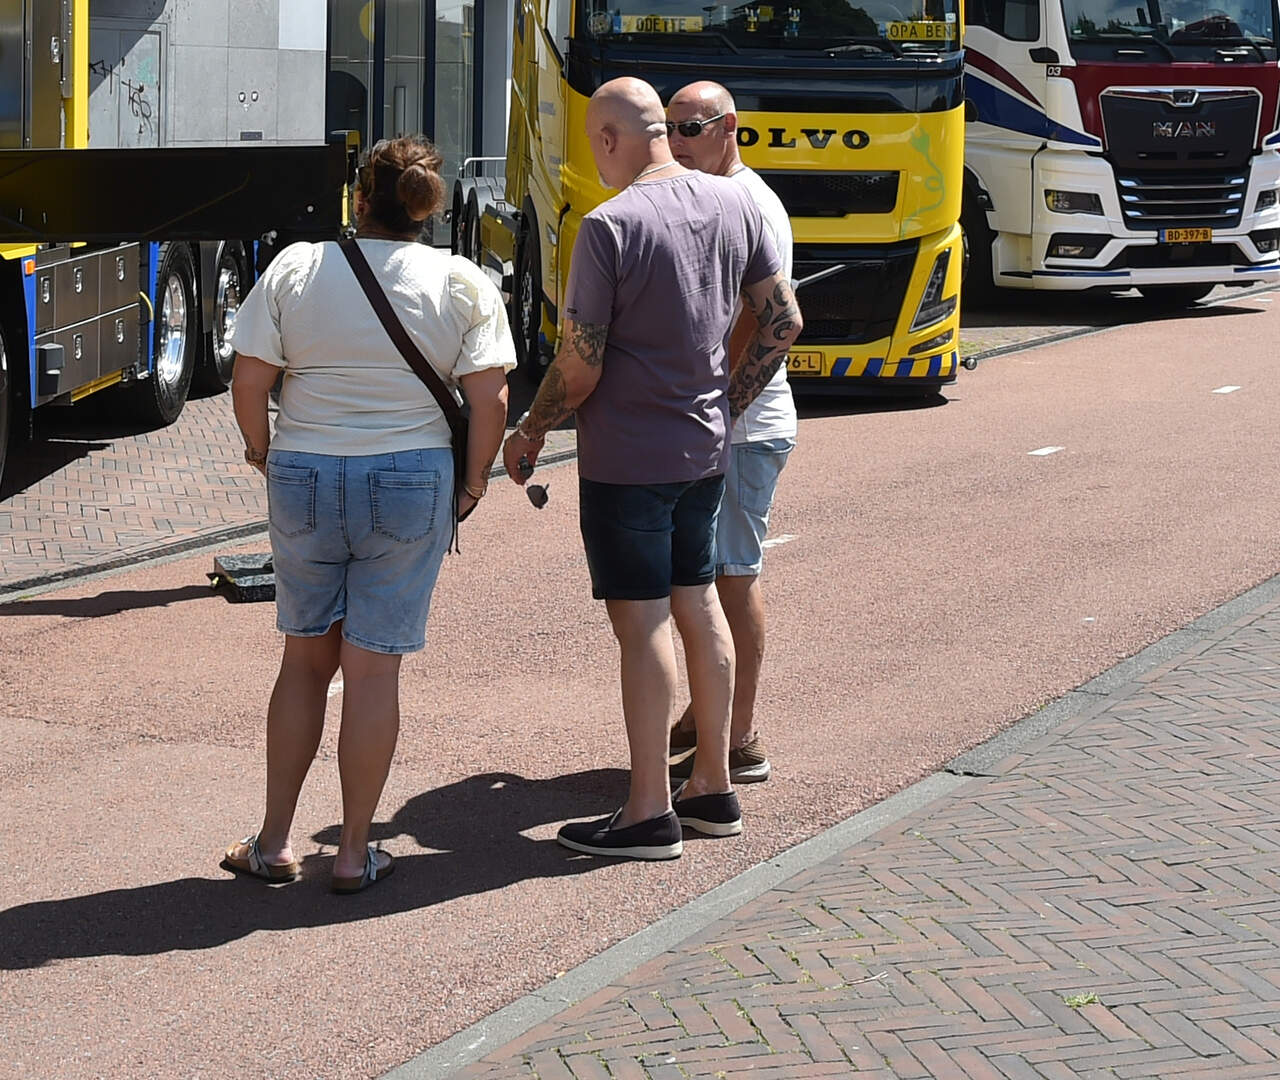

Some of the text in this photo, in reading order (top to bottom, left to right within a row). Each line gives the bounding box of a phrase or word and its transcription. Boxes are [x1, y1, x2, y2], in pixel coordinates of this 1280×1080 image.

[889, 24, 918, 38] OPA
[1047, 66, 1061, 76] 03
[1153, 122, 1217, 137] MAN
[736, 127, 870, 149] OLVO
